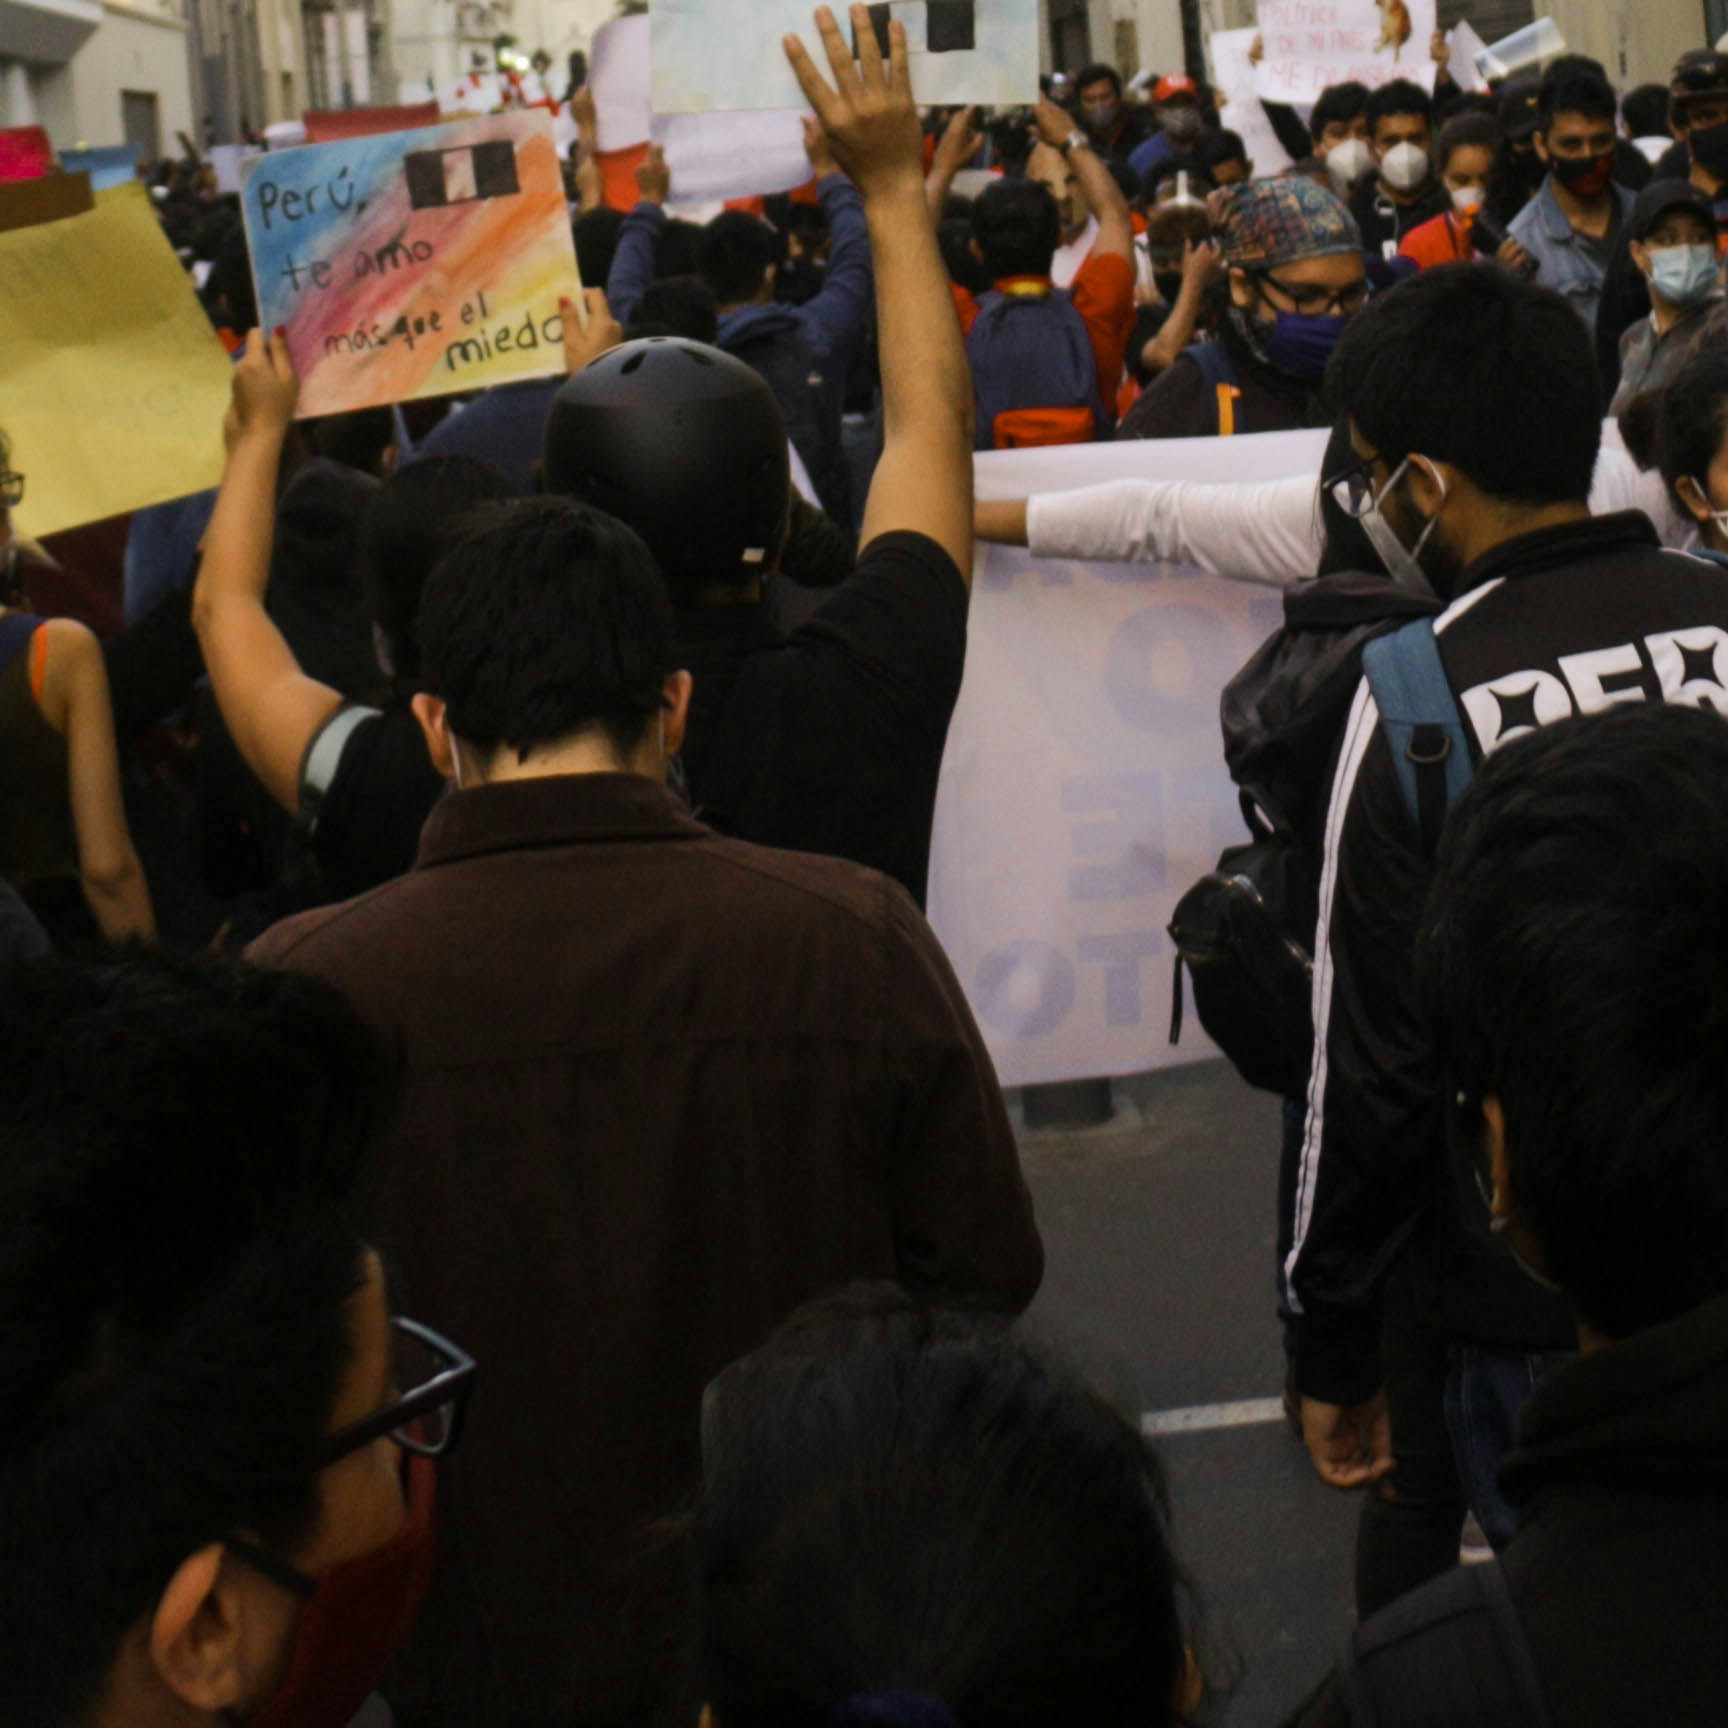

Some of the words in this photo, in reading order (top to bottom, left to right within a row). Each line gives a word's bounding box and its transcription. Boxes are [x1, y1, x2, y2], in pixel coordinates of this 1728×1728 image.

[281, 254, 331, 291] te
[353, 227, 433, 276] amo
[393, 309, 441, 350] que
[460, 291, 489, 322] el
[446, 312, 565, 372] miedo
